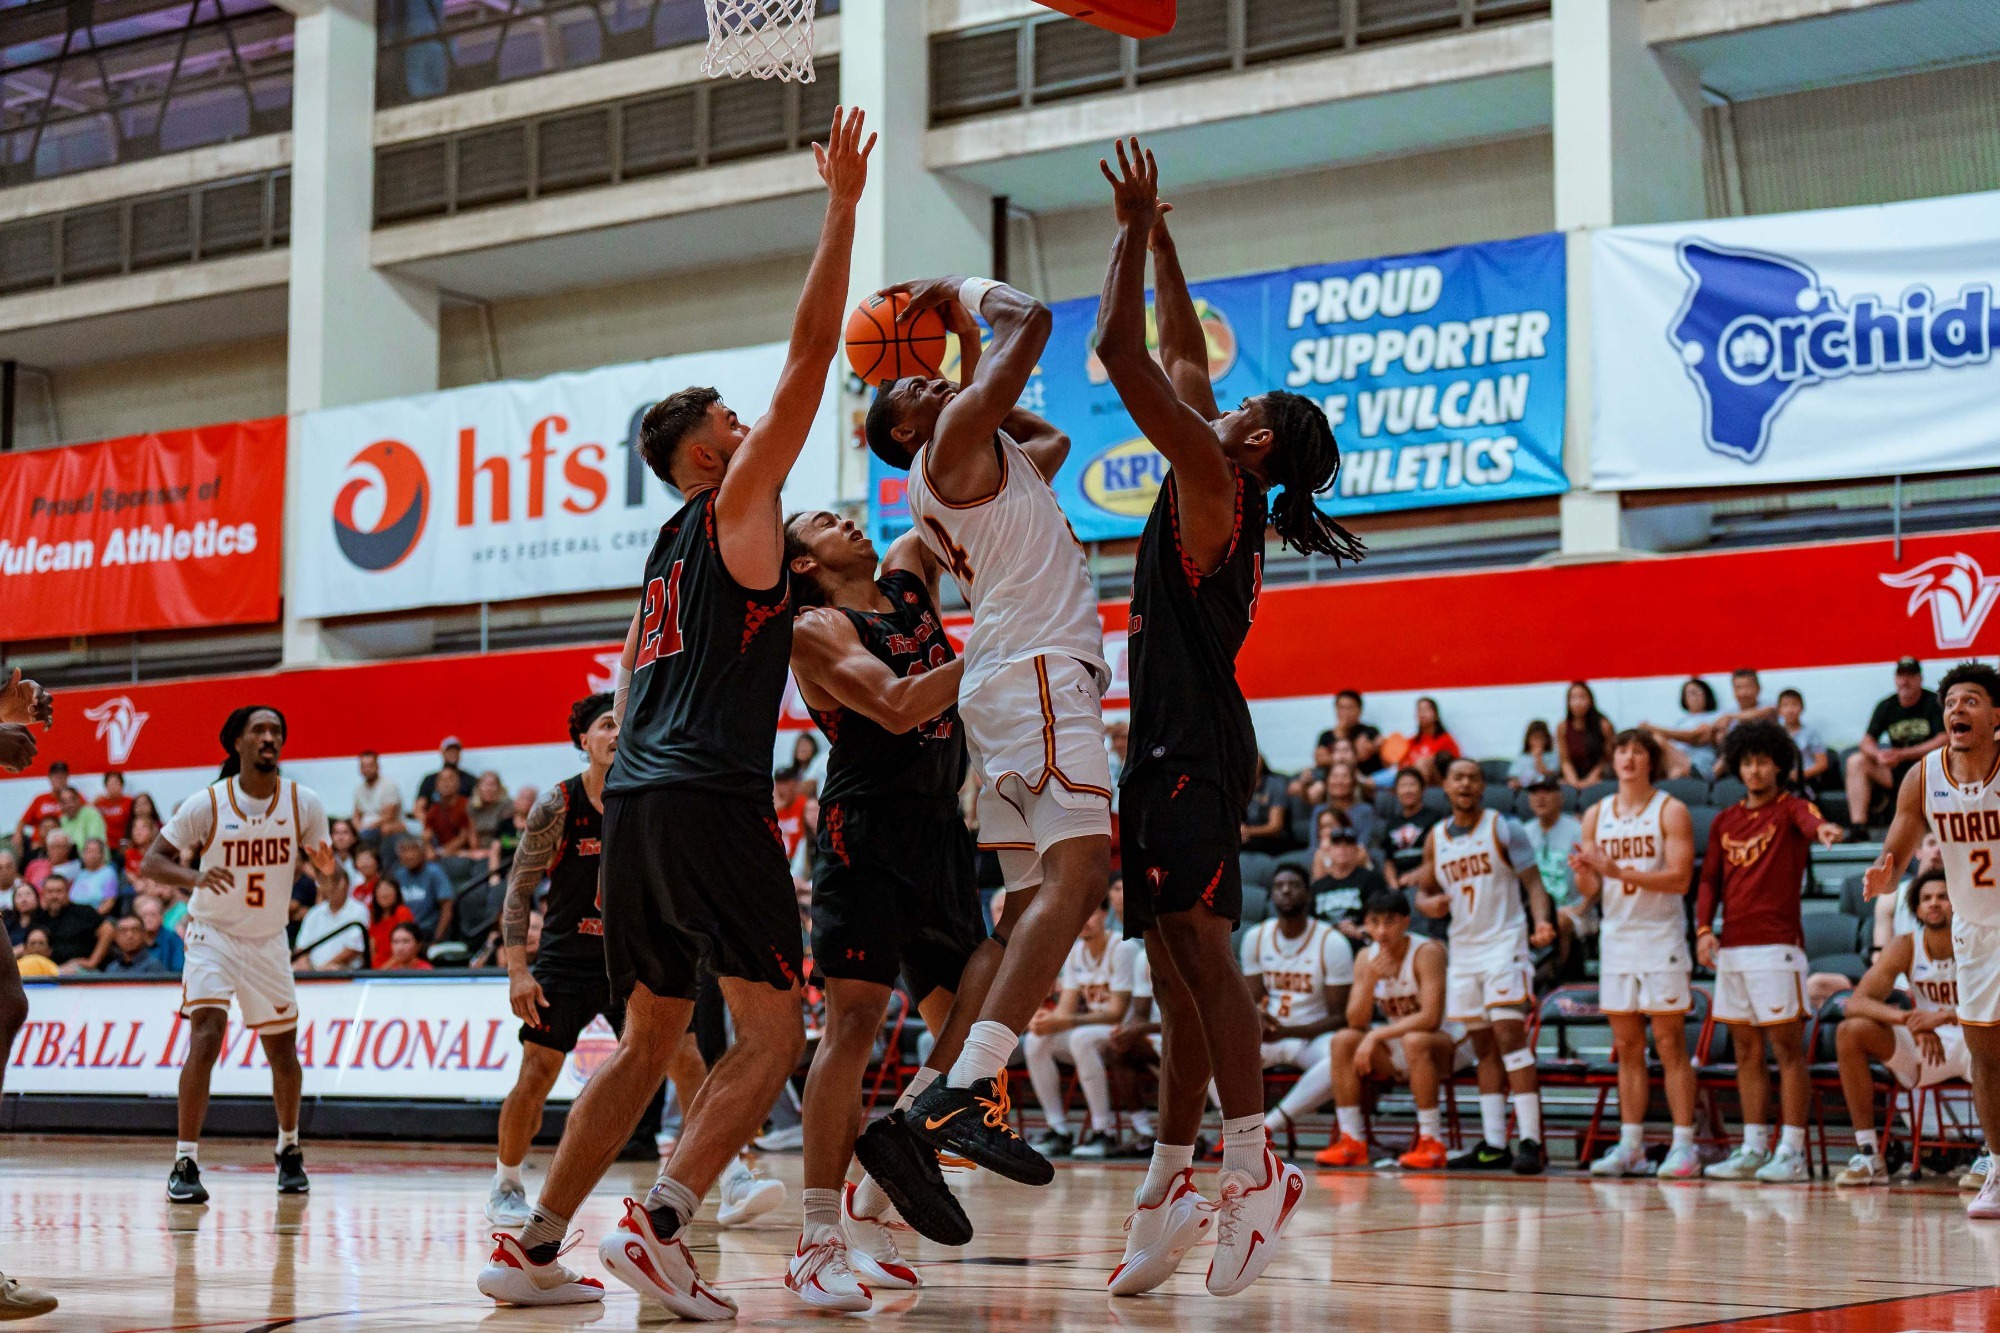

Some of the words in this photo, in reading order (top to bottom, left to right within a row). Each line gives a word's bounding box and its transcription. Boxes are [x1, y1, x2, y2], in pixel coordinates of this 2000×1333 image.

[1288, 265, 1443, 329] PROUD
[1286, 310, 1551, 388] SUPPORTER
[1310, 393, 1348, 432] F
[1358, 373, 1530, 438] VULCAN
[1312, 436, 1519, 499] HLETICS
[31, 492, 95, 518] Proud
[101, 485, 192, 513] Sponsor
[198, 475, 222, 501] of
[101, 517, 258, 568] Athletics
[516, 536, 601, 560] FEDERAL
[610, 530, 657, 551] CRE
[634, 559, 684, 674] 21
[1600, 835, 1656, 860] TOROS
[1932, 811, 2000, 843] TORO
[222, 837, 291, 868] TOROS
[1441, 852, 1493, 885] TOROS
[1969, 849, 1997, 889] 2
[245, 872, 266, 909] 5
[1461, 884, 1475, 915] 7
[12, 1020, 147, 1068] TBALL
[155, 1010, 509, 1071] IVIATIONAL
